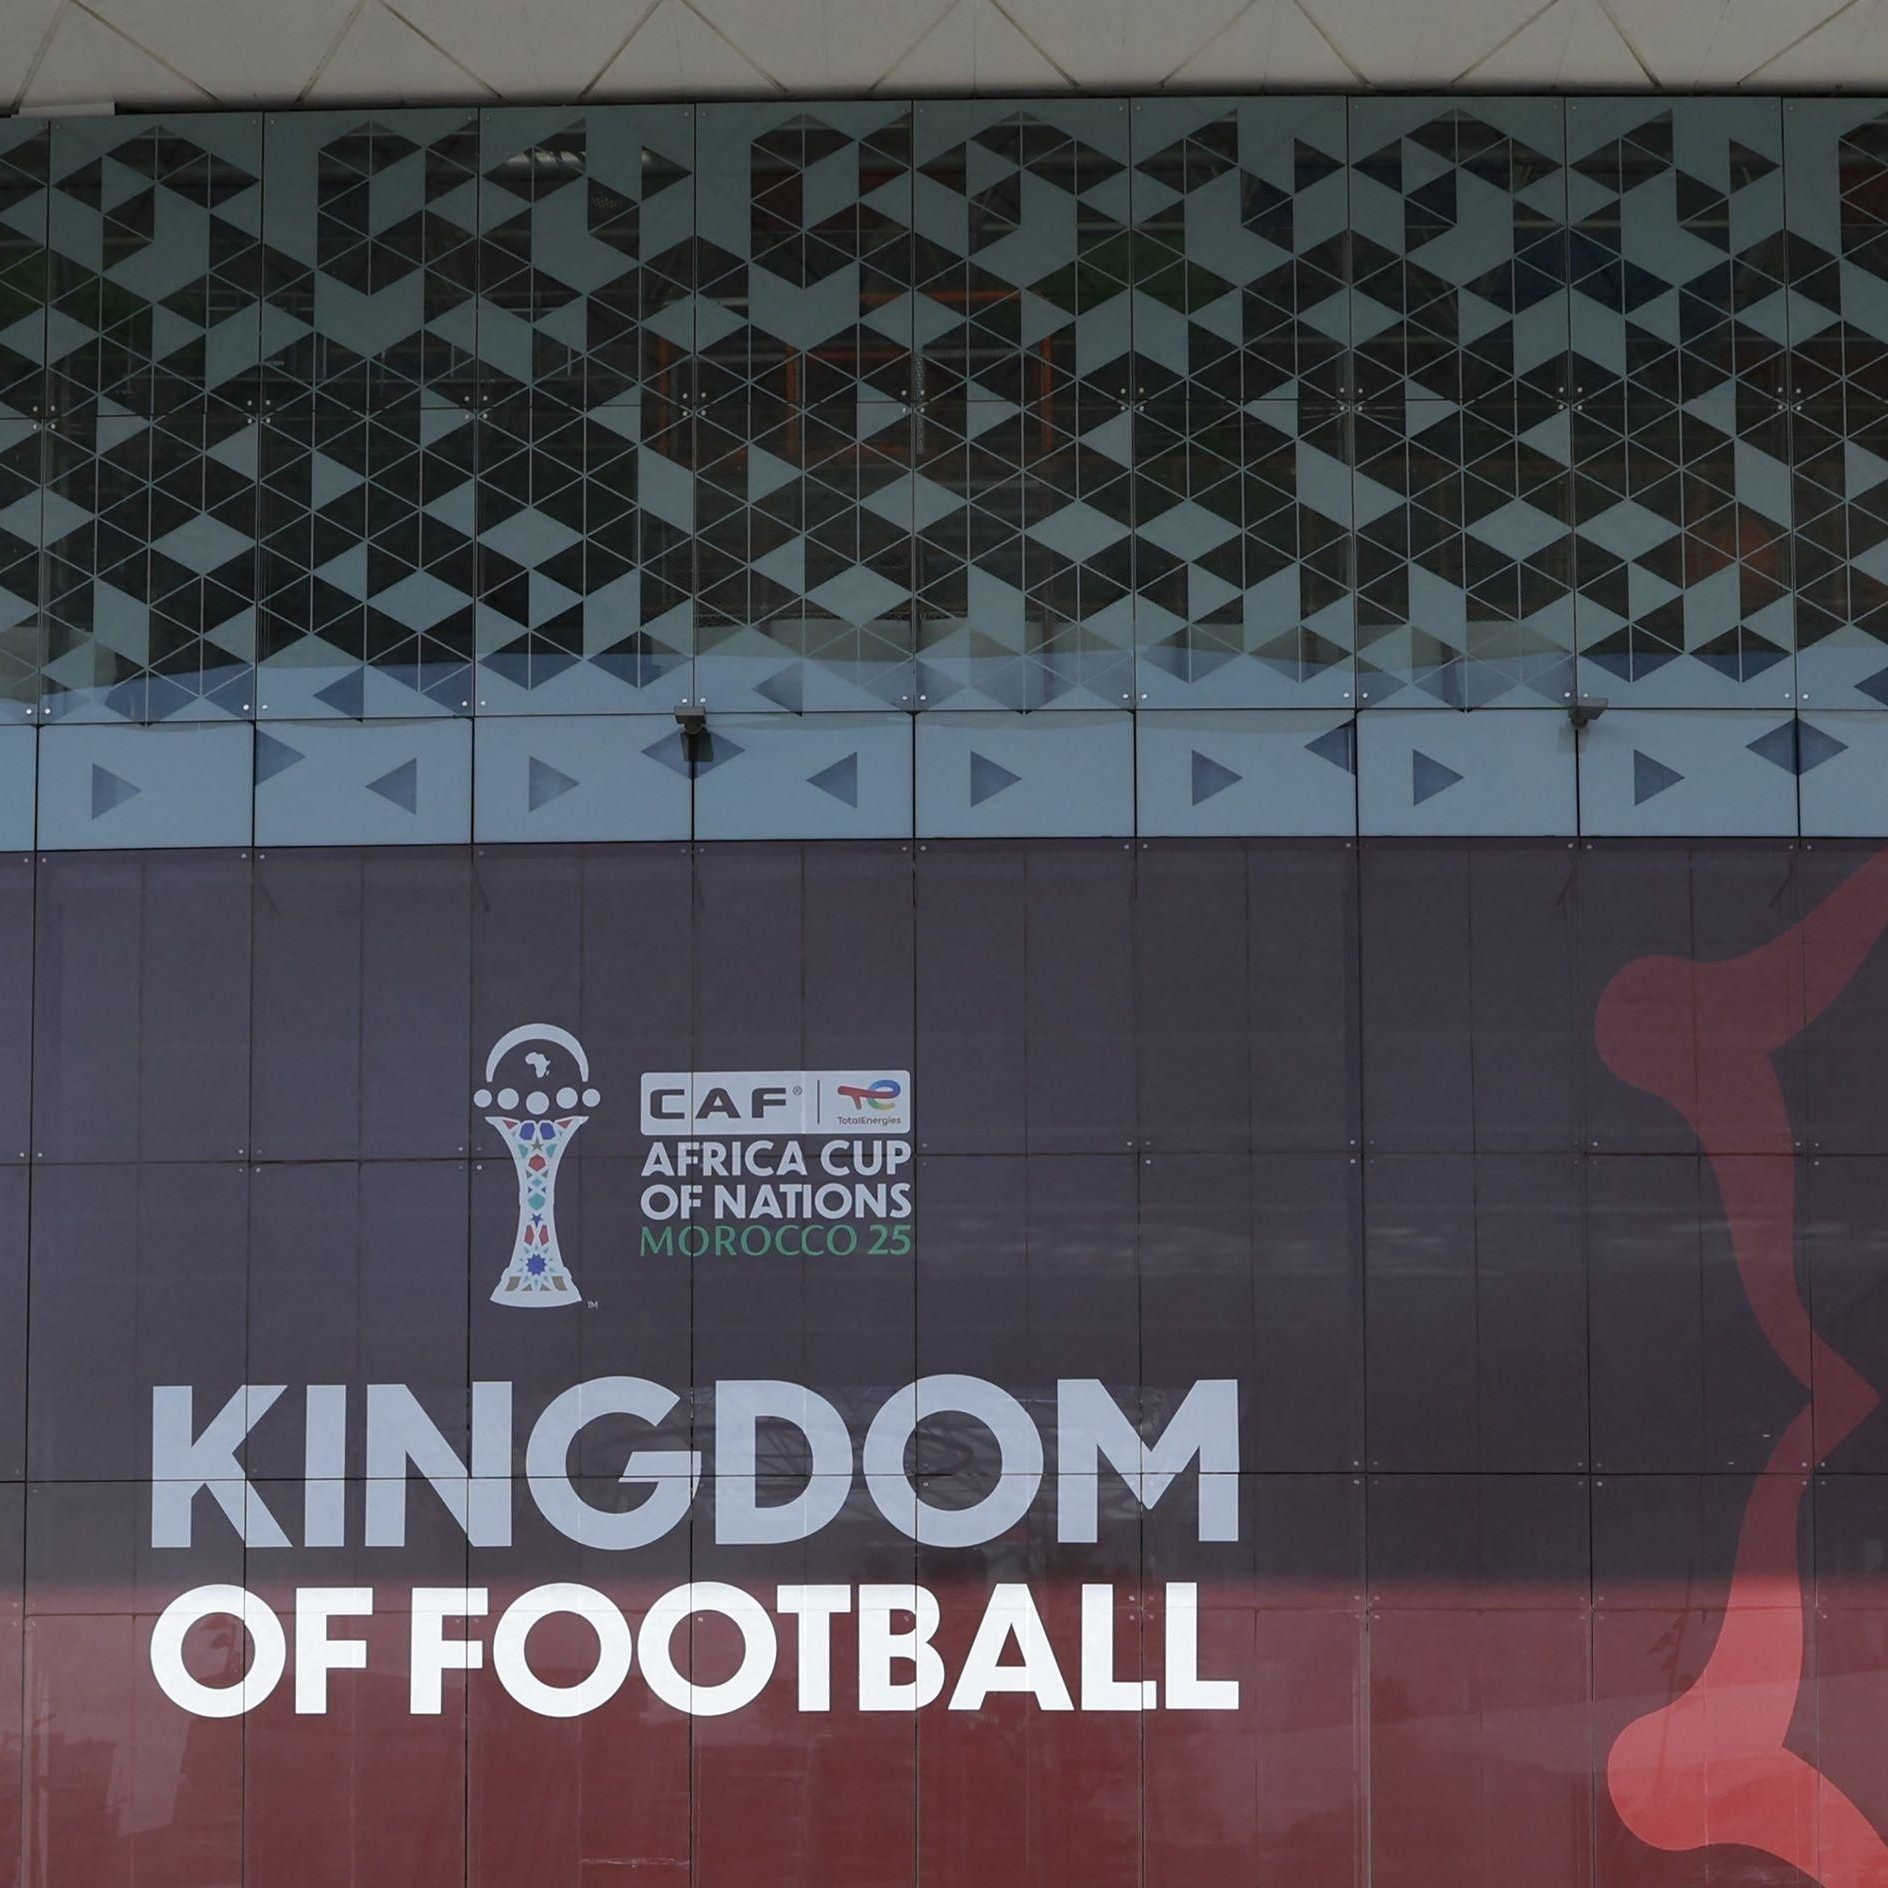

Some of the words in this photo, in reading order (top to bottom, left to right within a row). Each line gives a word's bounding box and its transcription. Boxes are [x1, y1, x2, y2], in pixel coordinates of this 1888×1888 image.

[836, 1115, 901, 1126] TotalEnergies
[641, 1140, 808, 1177] AFRICA
[820, 1139, 912, 1176] CUP
[640, 1184, 703, 1221] OF
[714, 1183, 912, 1219] NATIONS
[640, 1224, 857, 1258] MOROCCO
[867, 1224, 912, 1256] 25
[150, 1373, 1240, 1552] KINGDOM
[149, 1583, 374, 1719] OF
[410, 1580, 1240, 1718] FOOTBALL
